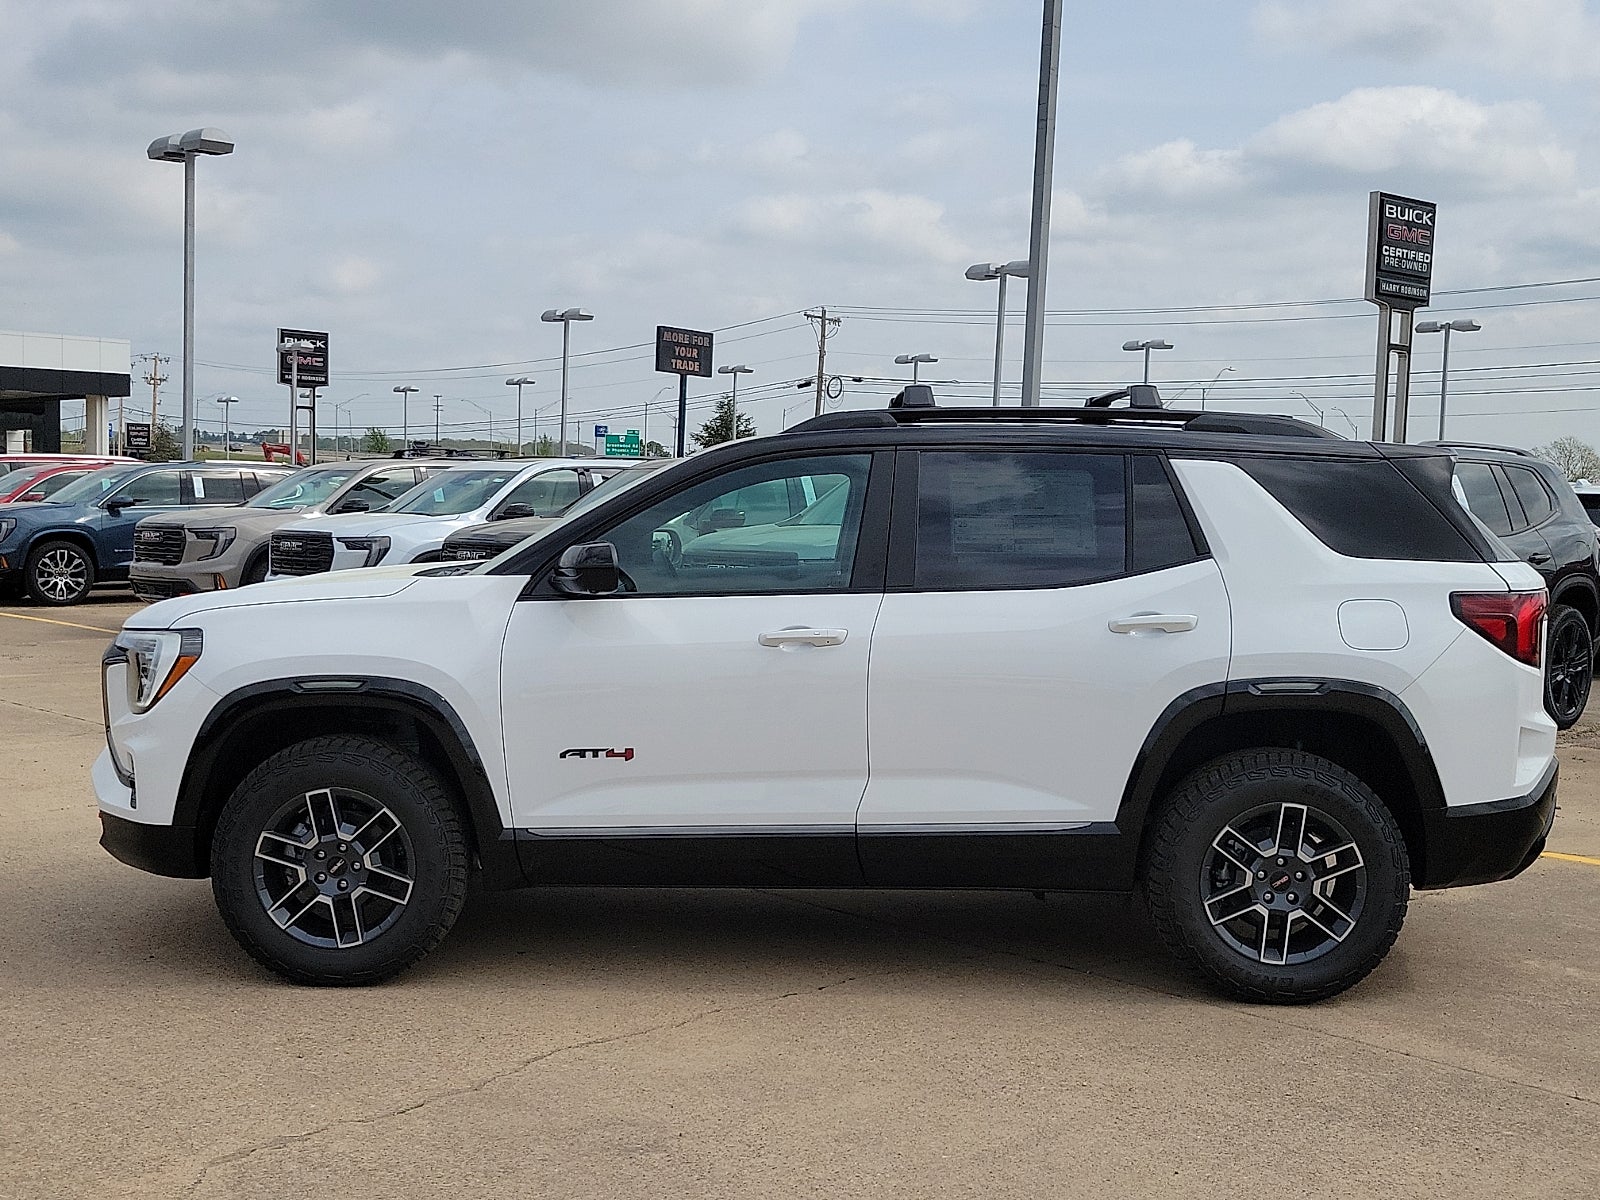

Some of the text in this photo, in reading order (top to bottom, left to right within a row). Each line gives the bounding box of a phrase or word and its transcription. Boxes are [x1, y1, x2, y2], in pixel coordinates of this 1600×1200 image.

[1385, 204, 1433, 225] BUICK
[1387, 223, 1431, 246] GMC
[1382, 245, 1431, 263] CERTIFIED
[1384, 256, 1428, 272] PRE-OWNED
[1381, 282, 1428, 298] HARRY ROBINSON
[663, 331, 710, 347] MORE FOR
[674, 345, 698, 359] YOUR
[671, 358, 700, 371] TRADE
[559, 748, 635, 762] AT4
